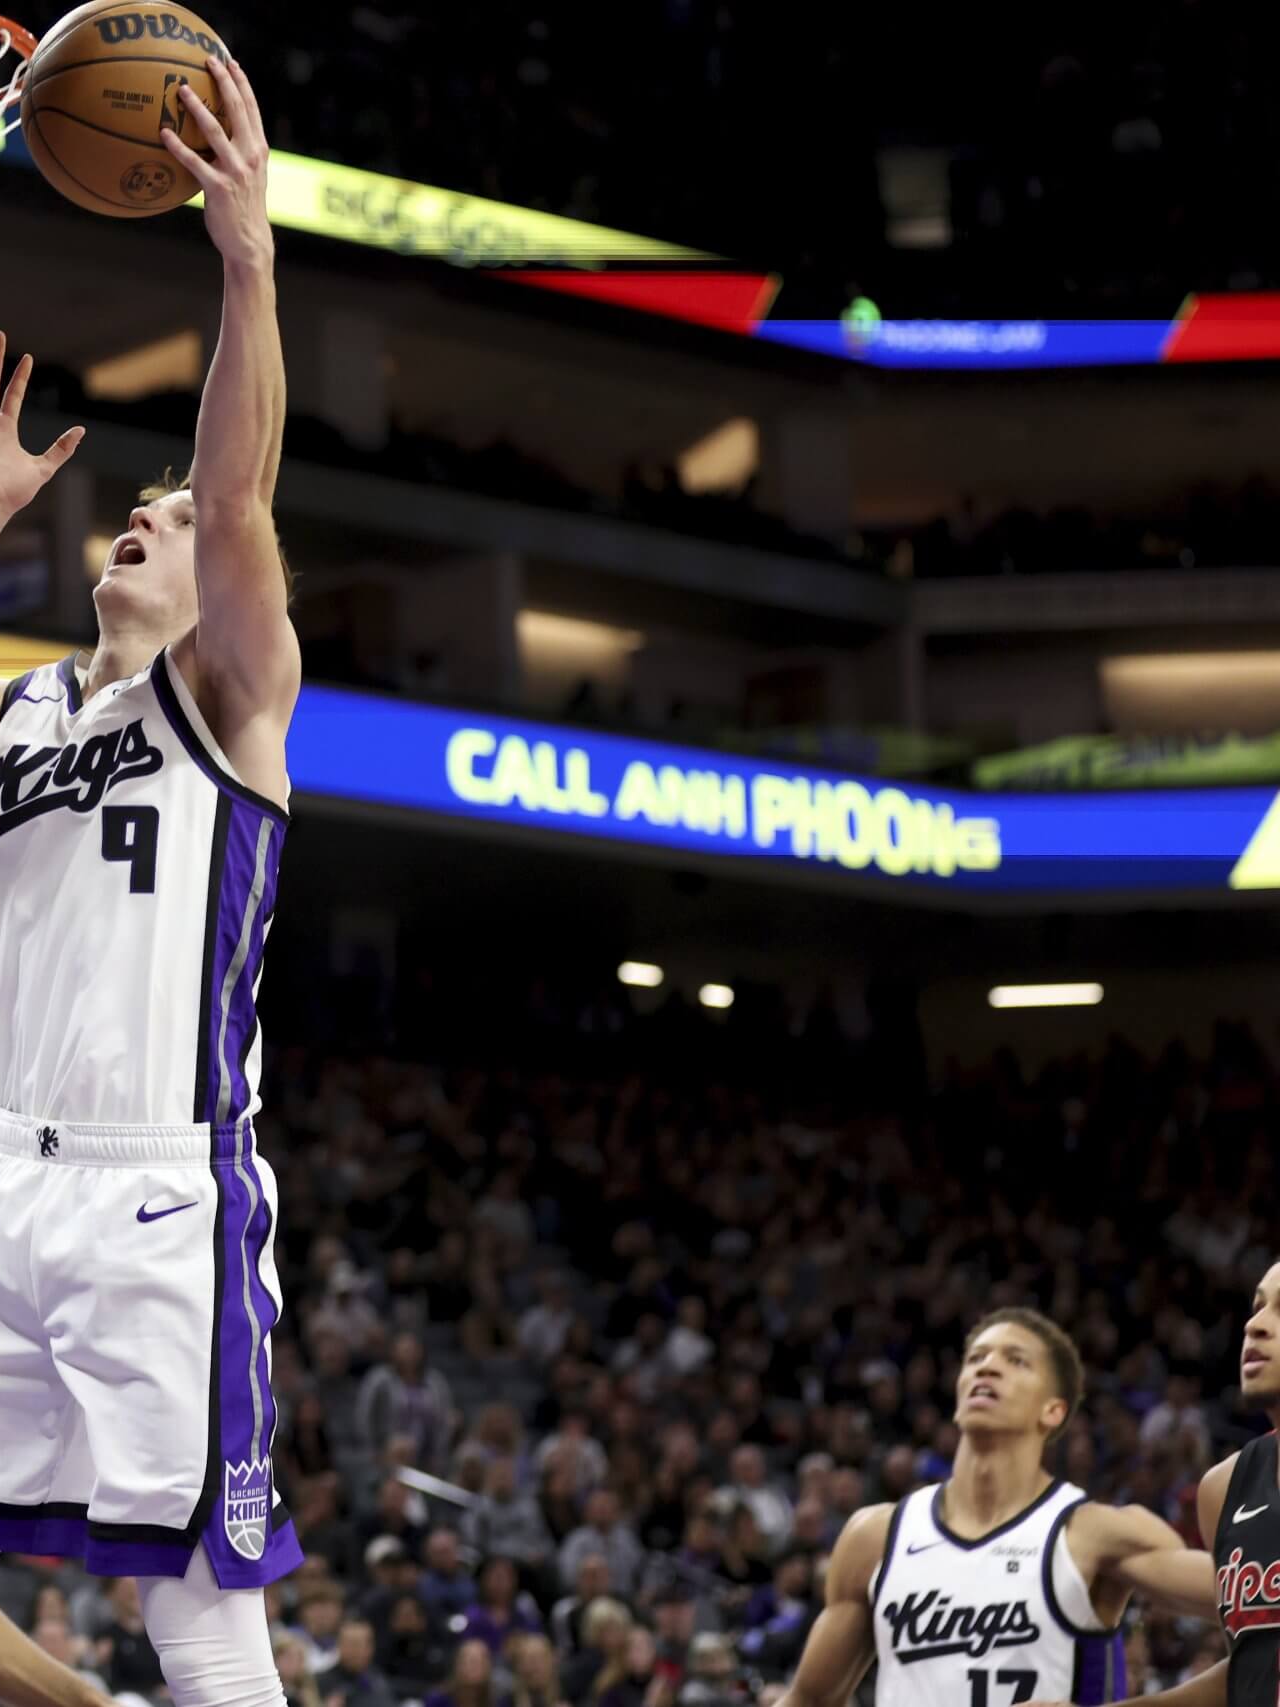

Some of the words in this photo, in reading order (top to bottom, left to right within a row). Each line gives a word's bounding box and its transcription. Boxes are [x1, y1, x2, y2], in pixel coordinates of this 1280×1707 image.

[446, 728, 610, 817] CALL
[614, 760, 746, 838] ANH
[751, 773, 1001, 877] PHOONG
[102, 806, 159, 894] 9
[885, 1590, 1040, 1665] Kings
[967, 1669, 1038, 1707] 17
